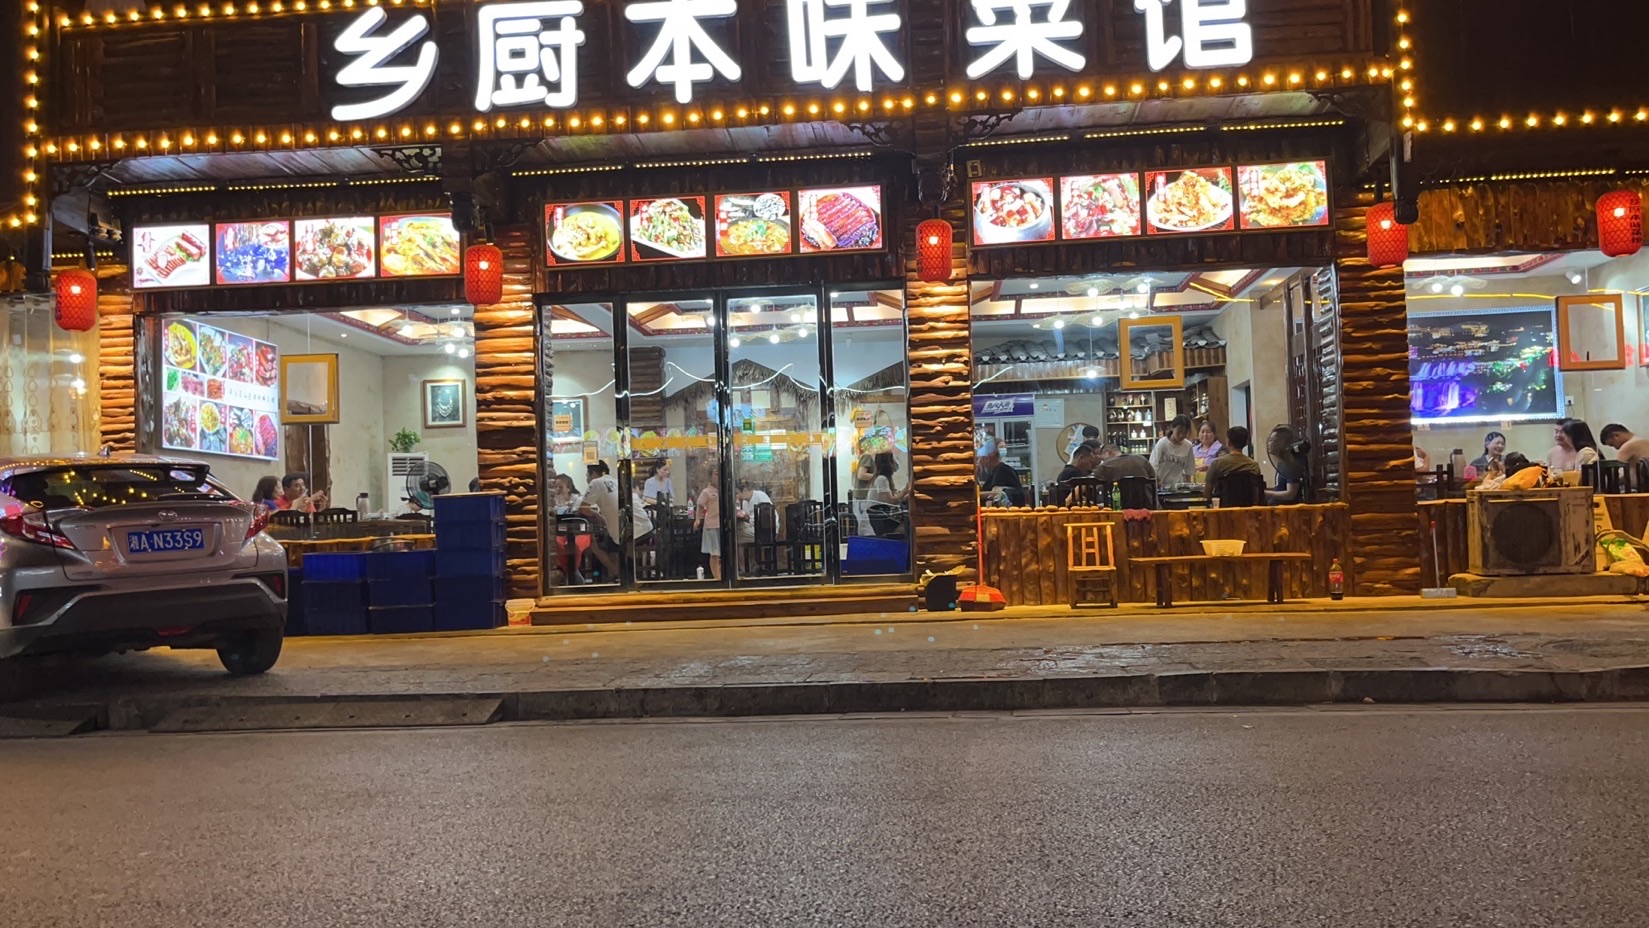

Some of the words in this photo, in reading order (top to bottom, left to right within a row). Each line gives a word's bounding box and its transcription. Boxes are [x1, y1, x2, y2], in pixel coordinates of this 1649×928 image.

[331, 0, 1253, 121] 乡厨本味菜馆
